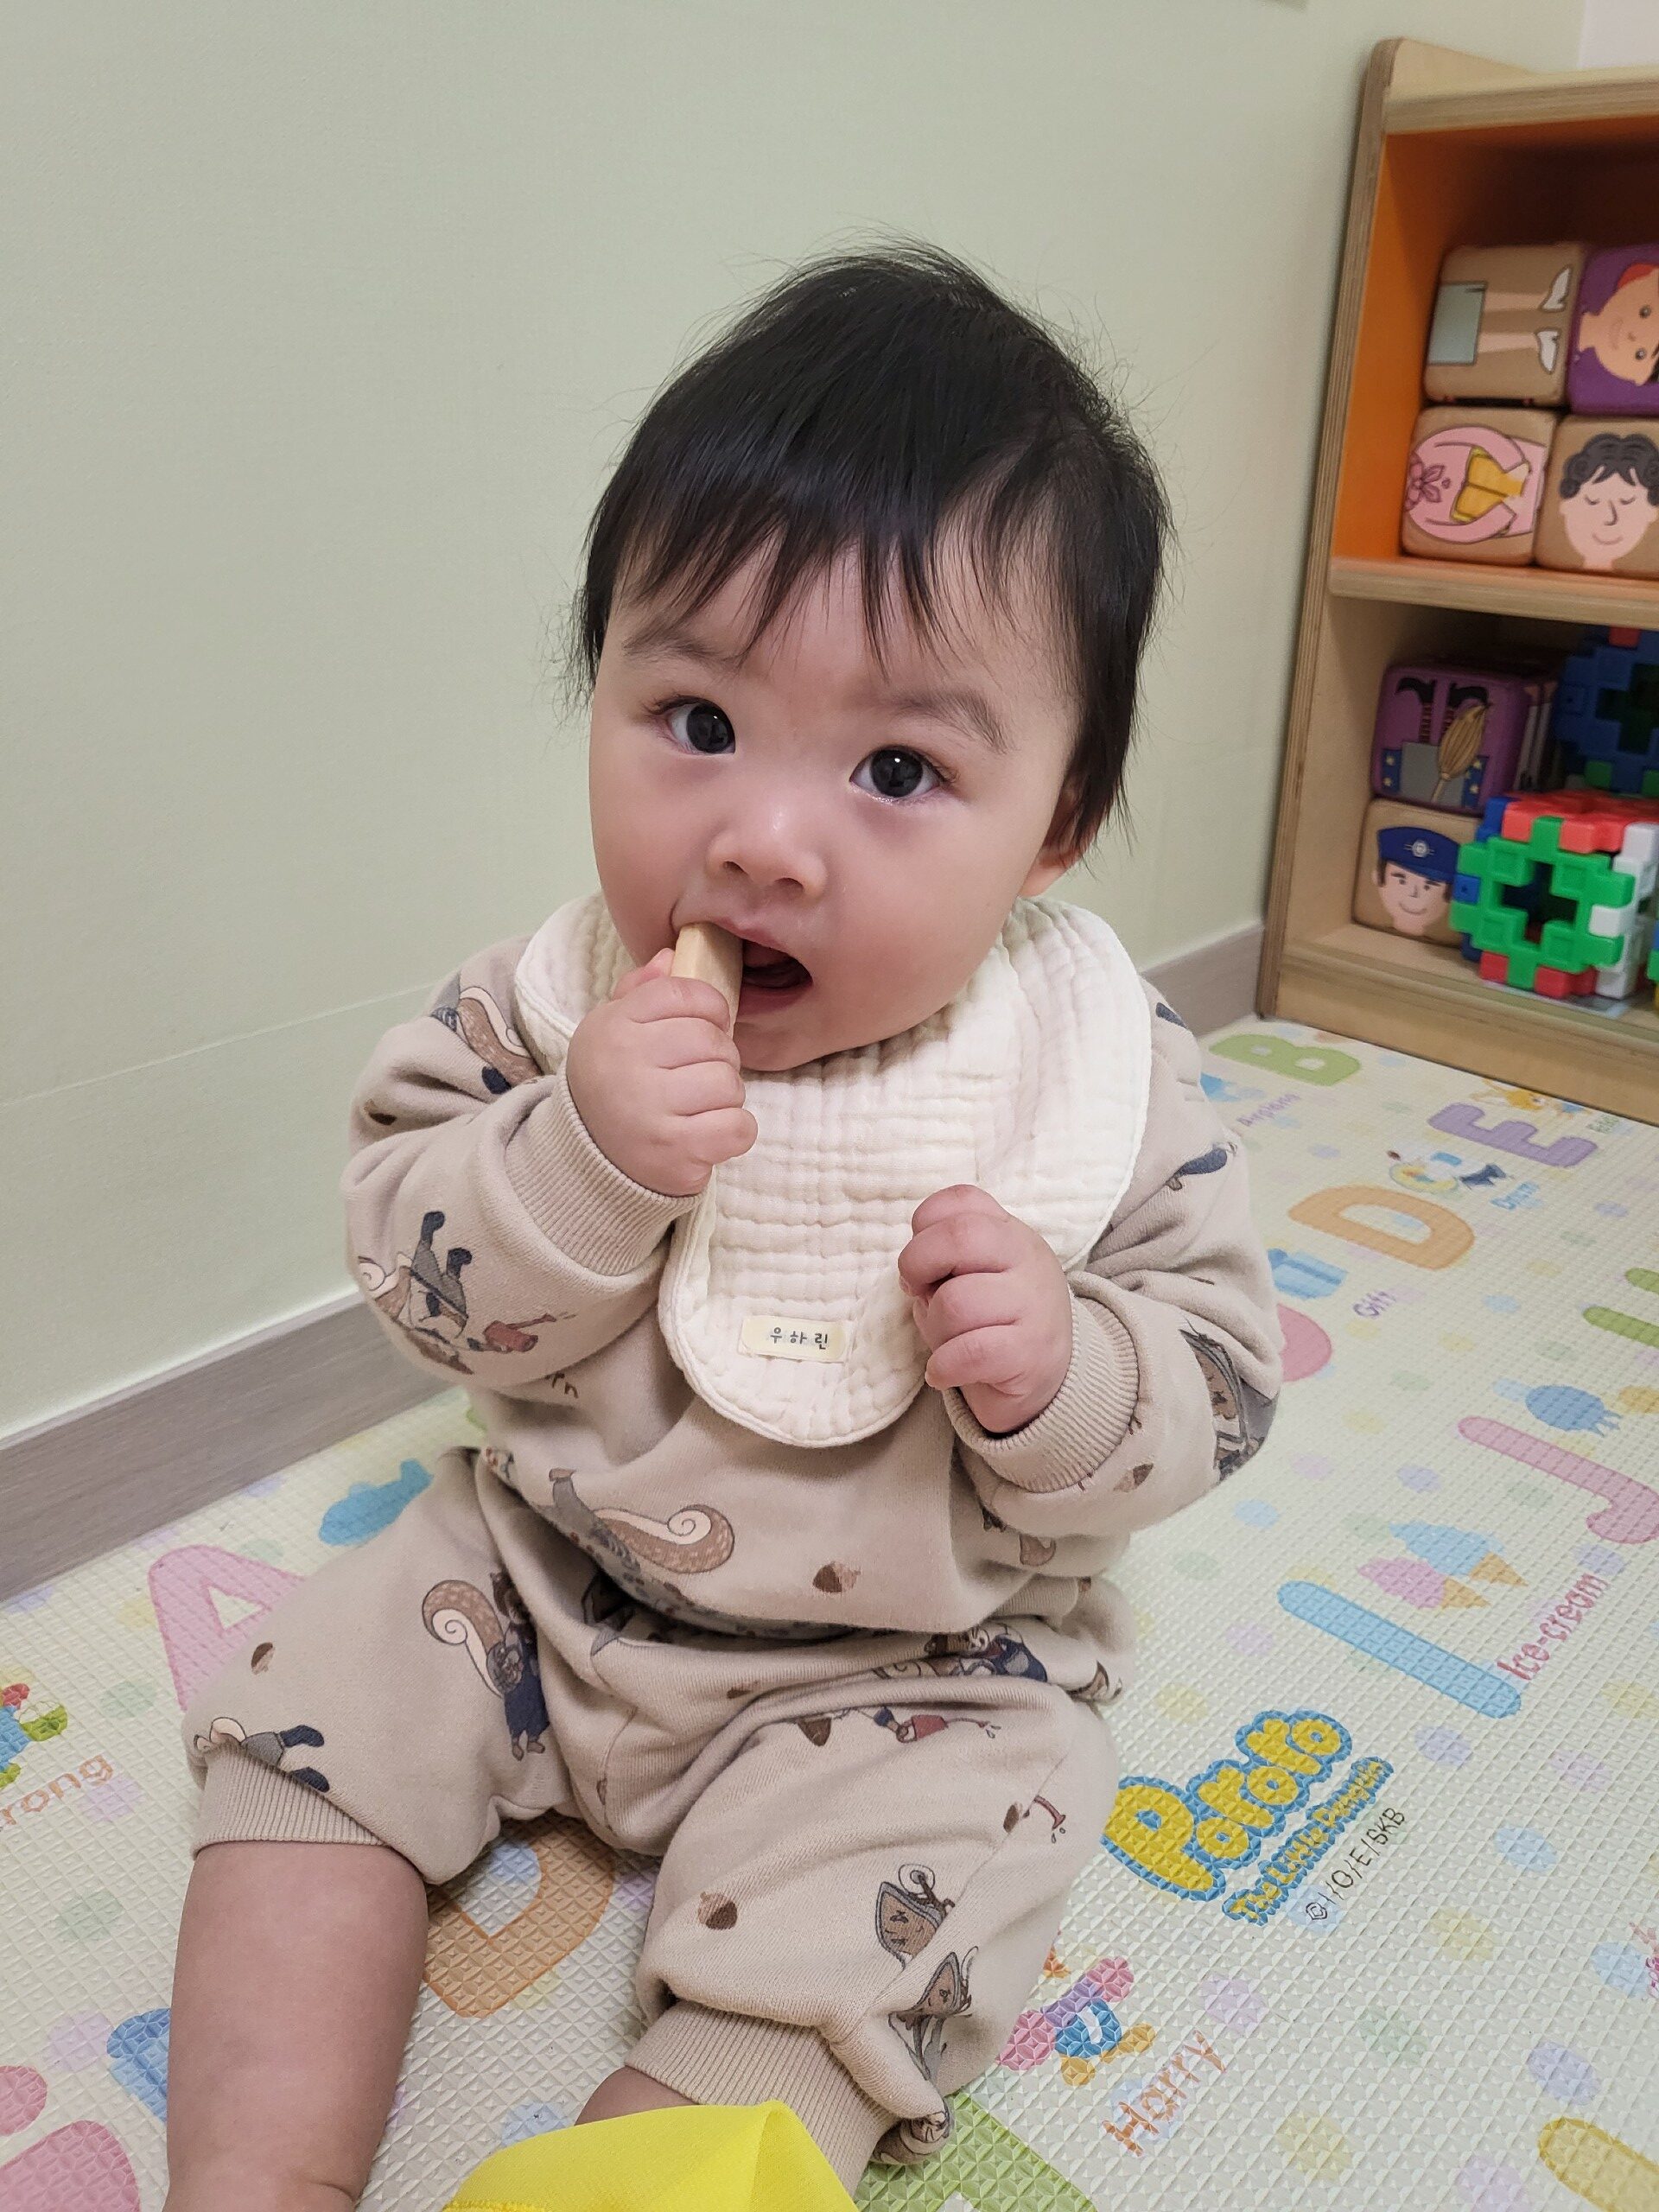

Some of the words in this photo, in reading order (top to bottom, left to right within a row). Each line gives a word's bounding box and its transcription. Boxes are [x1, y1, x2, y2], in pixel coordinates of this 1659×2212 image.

[1209, 1033, 1362, 1086] B
[1427, 1102, 1598, 1167] E
[1287, 1184, 1475, 1270] D
[770, 1326, 828, 1350] 우하린
[1497, 1573, 1611, 1681] Ice-cream
[1100, 1709, 1352, 1902] Pororo
[1222, 1882, 1282, 1927] The
[1102, 2030, 1226, 2157] Harry
